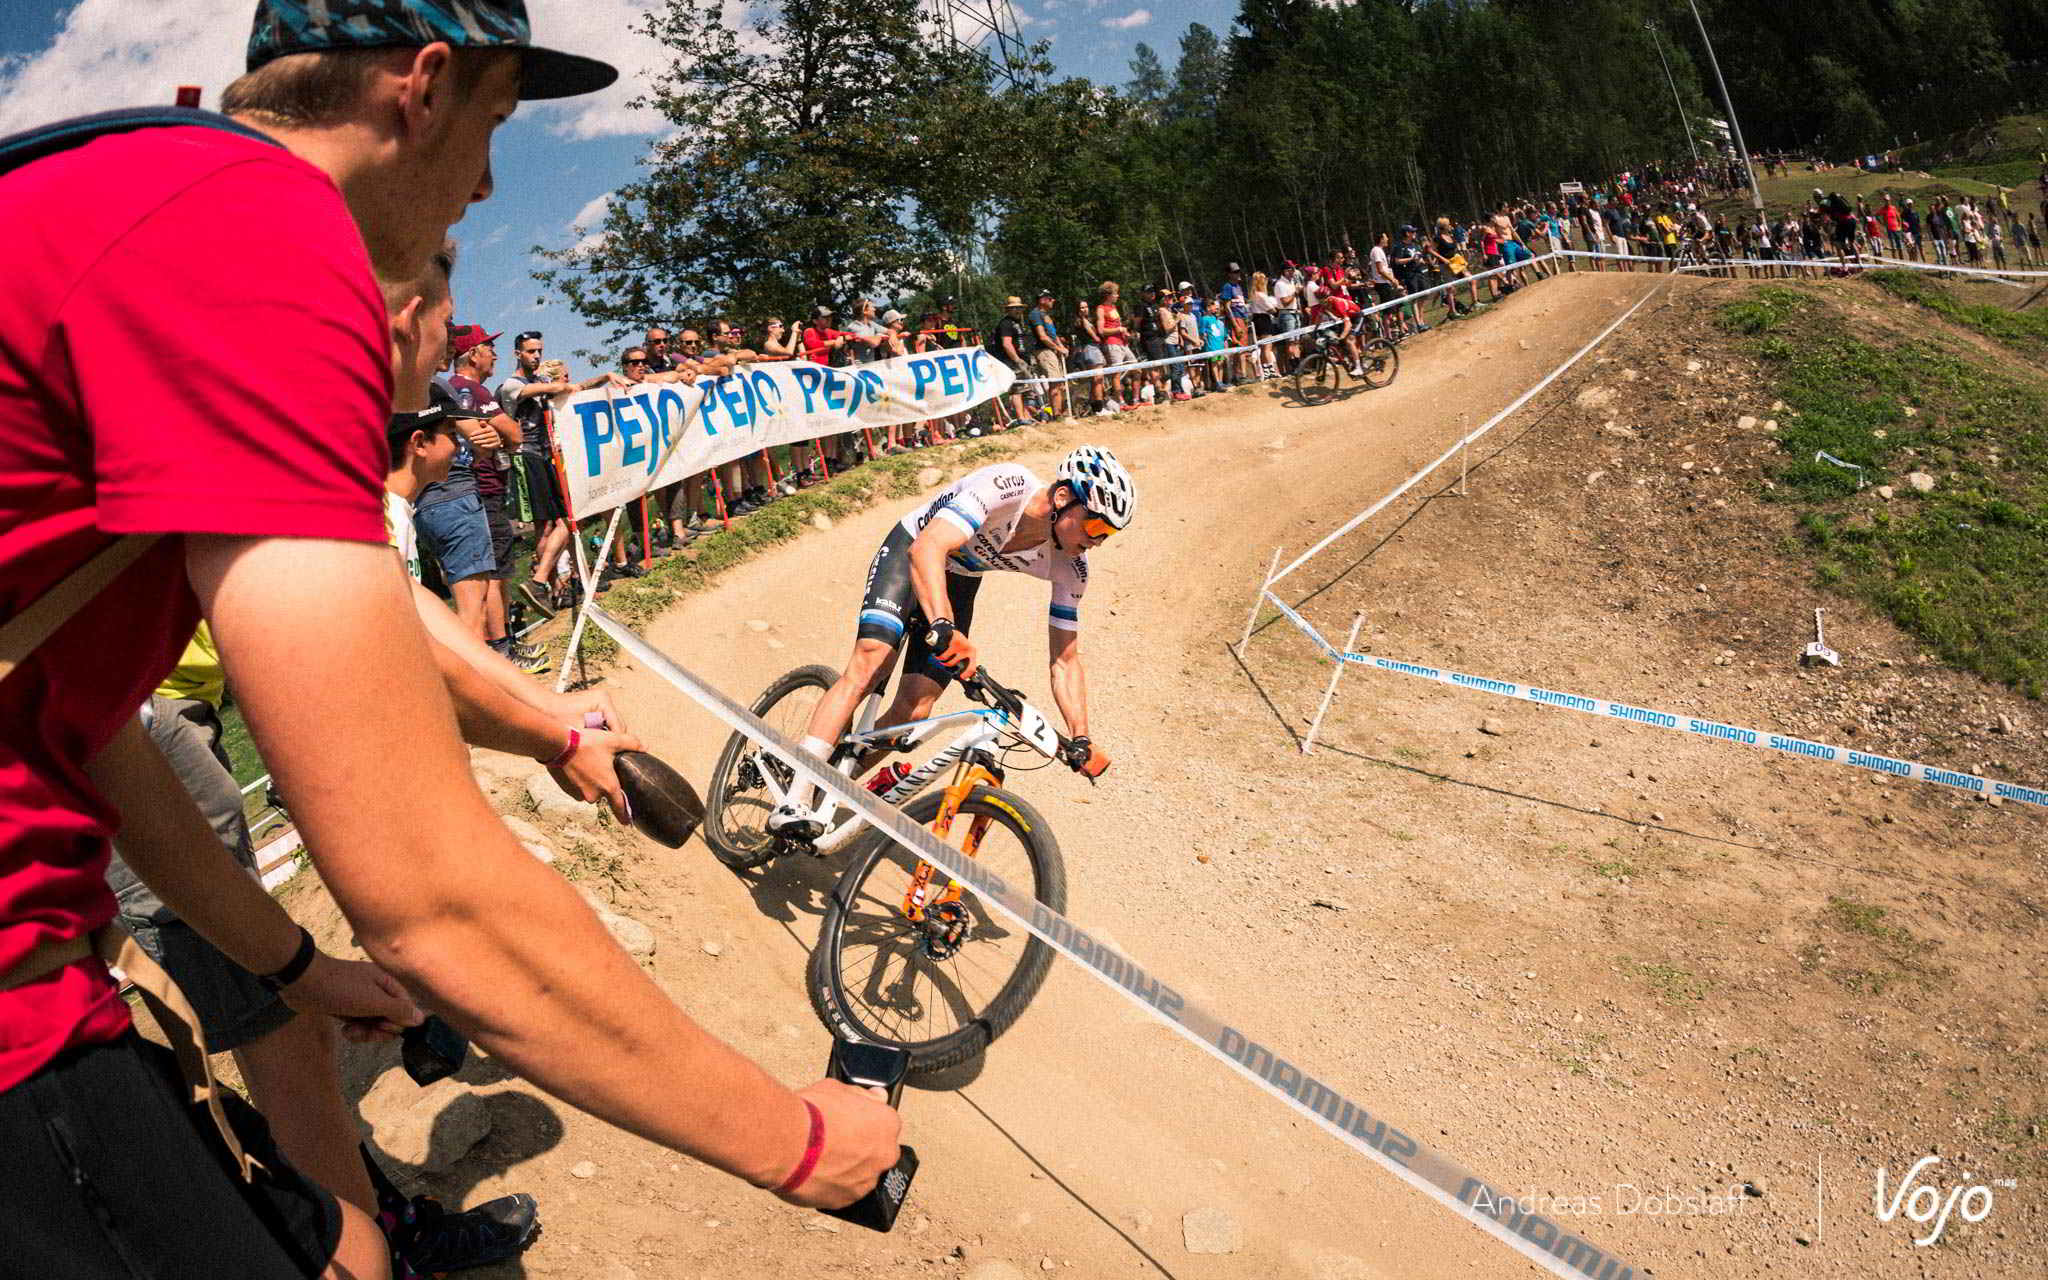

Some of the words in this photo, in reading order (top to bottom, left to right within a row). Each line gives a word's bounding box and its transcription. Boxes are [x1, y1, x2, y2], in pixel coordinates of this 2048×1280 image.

[574, 389, 685, 477] PEJO
[993, 474, 1026, 491] Circus
[1529, 687, 1596, 712] SHIMANO
[1033, 716, 1046, 742] 2
[1609, 703, 1677, 729] SHIMANO
[1690, 719, 1757, 745] SHIMANO
[1770, 735, 1836, 761] SHIMANO
[882, 746, 964, 804] CANYON
[1848, 751, 1912, 776] SHIMANO
[1923, 767, 1984, 791] SHIMANO
